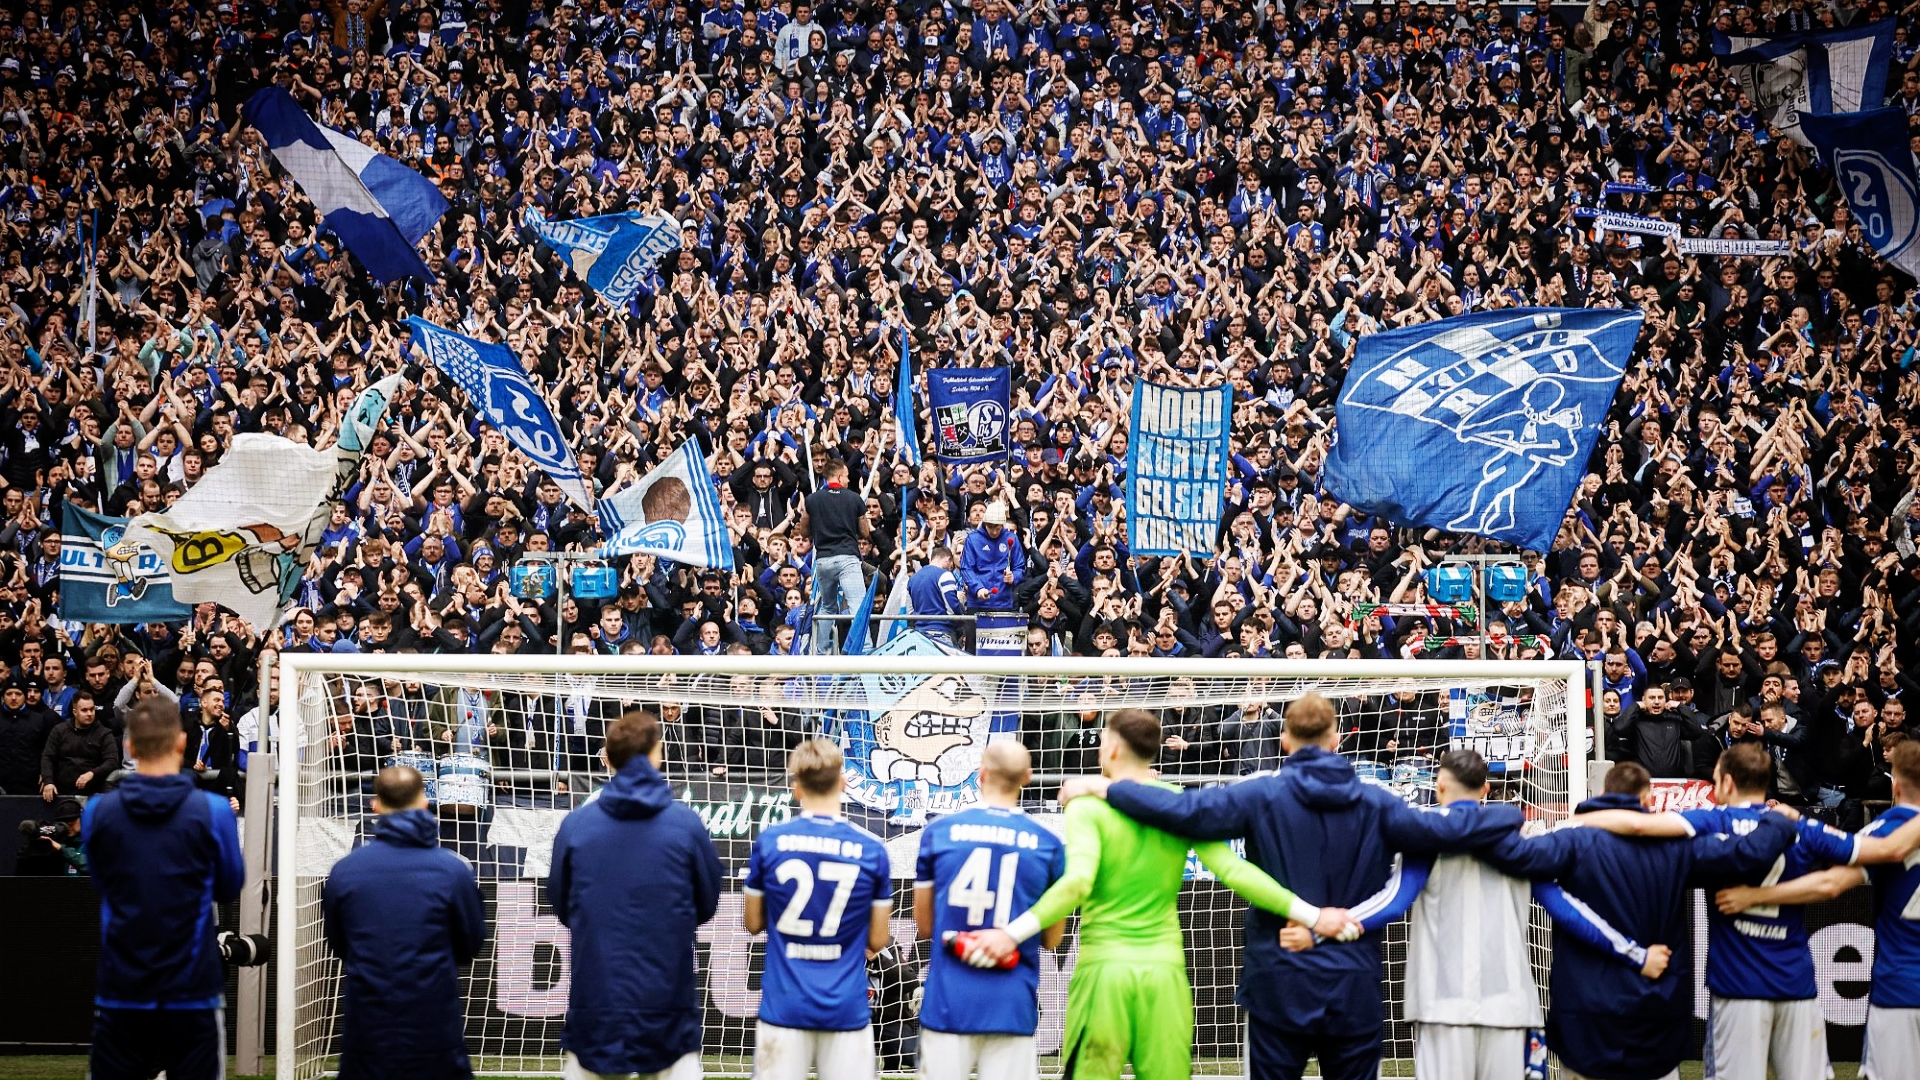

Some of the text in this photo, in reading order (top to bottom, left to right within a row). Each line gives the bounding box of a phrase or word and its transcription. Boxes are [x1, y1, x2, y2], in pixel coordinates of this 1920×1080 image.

[1602, 216, 1674, 233] PARKSTADION
[1684, 239, 1757, 255] EUROFIGHTER
[1140, 383, 1223, 438] NORD
[1137, 433, 1221, 481] KURVE
[1136, 477, 1219, 521] GELSEN
[1135, 517, 1217, 553] KIRCHEN
[931, 777, 981, 811] RA
[1651, 782, 1715, 814] TRAS
[759, 793, 793, 834] 75
[776, 834, 864, 860] SCHALKE 04
[950, 824, 1039, 850] SCHALKE 04
[775, 858, 861, 938] 27
[948, 847, 1020, 928] 41
